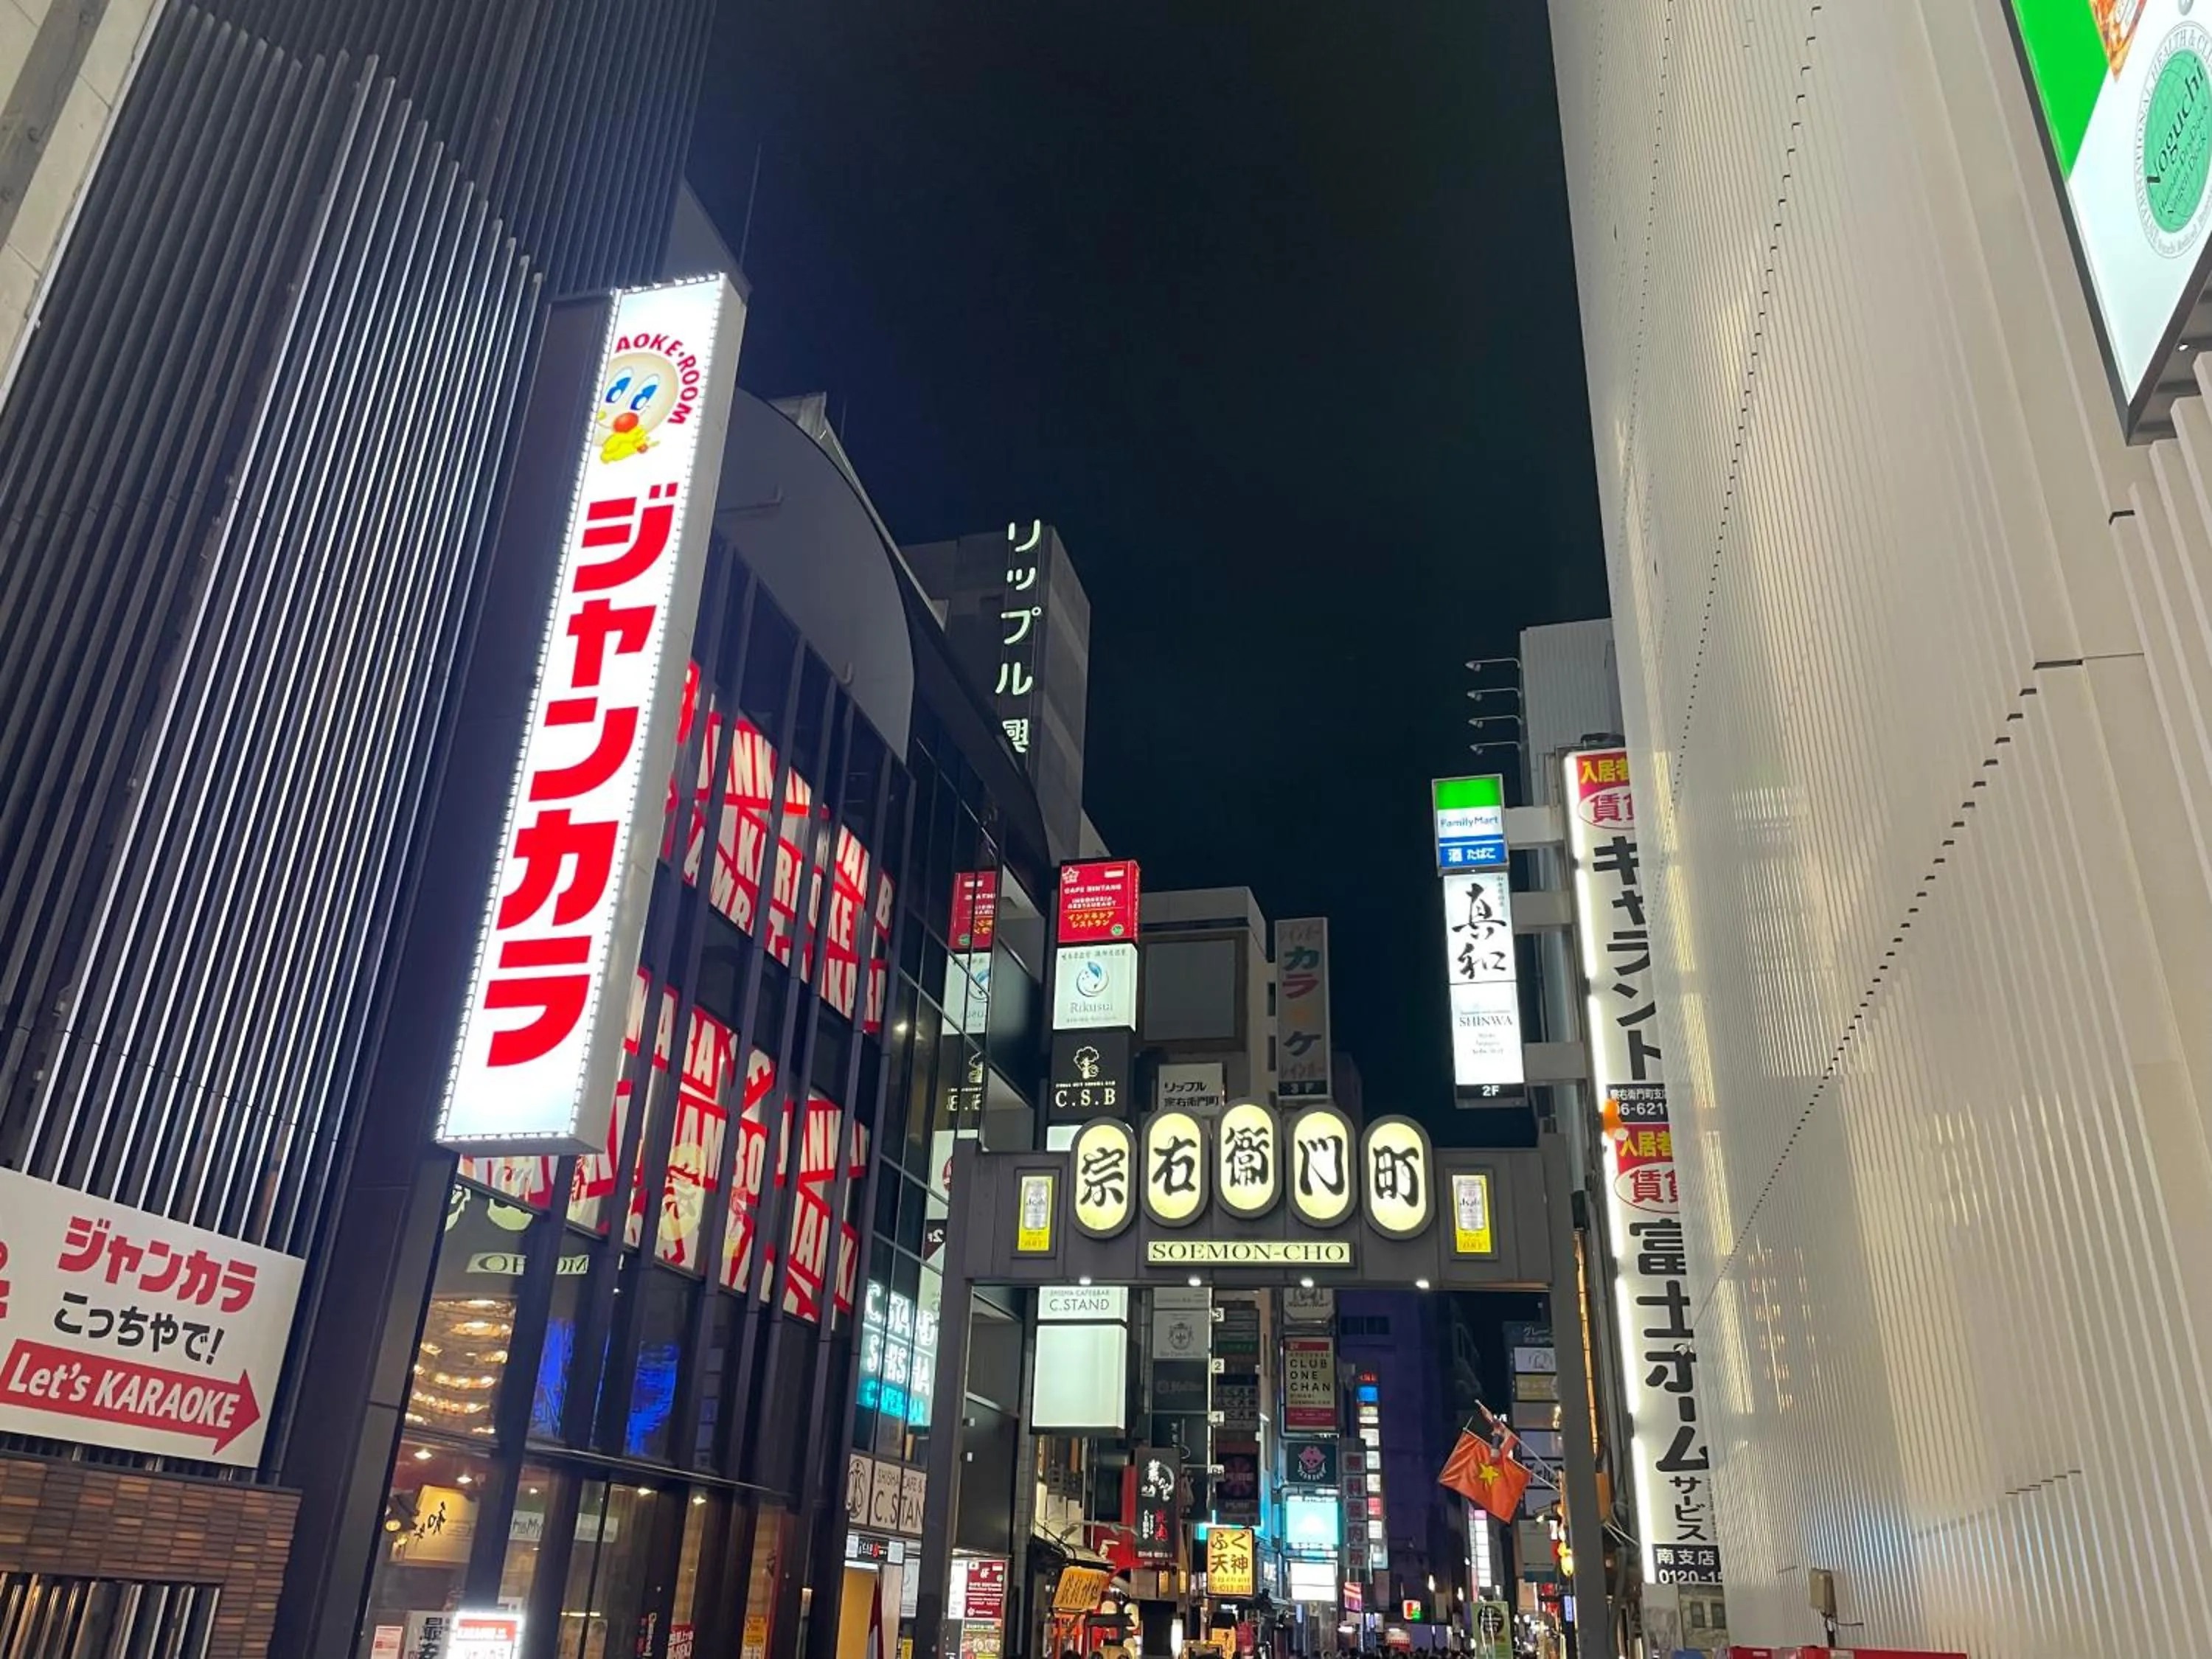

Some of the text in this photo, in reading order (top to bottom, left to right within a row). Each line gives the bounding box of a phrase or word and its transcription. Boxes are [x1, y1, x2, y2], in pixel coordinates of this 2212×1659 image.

[2146, 57, 2204, 198] Noguchi
[483, 481, 678, 1067] ジャンカラ
[1440, 815, 1499, 827] FamilyMart
[1466, 847, 1497, 860] たばこ
[1459, 1015, 1513, 1027] SHINWA
[1482, 1085, 1500, 1096] 2F
[1151, 1242, 1346, 1262] SOEMON-CHO
[58, 1216, 257, 1313] ジャンカラ
[1049, 1298, 1110, 1312] C.STAND
[54, 1291, 225, 1365] こっちやで!
[1629, 1217, 1709, 1473] 富士ホーム
[1214, 1362, 1221, 1371] 2
[1290, 1359, 1328, 1368] CLUB
[1290, 1371, 1318, 1380] ONE
[7, 1352, 240, 1429] Let's KARAOKE
[1290, 1382, 1331, 1391] CHAN
[1669, 1475, 1708, 1541] サービス
[1211, 1531, 1249, 1551] ふぐ
[1210, 1554, 1248, 1575] 天神
[1655, 1548, 1715, 1566] 南支店
